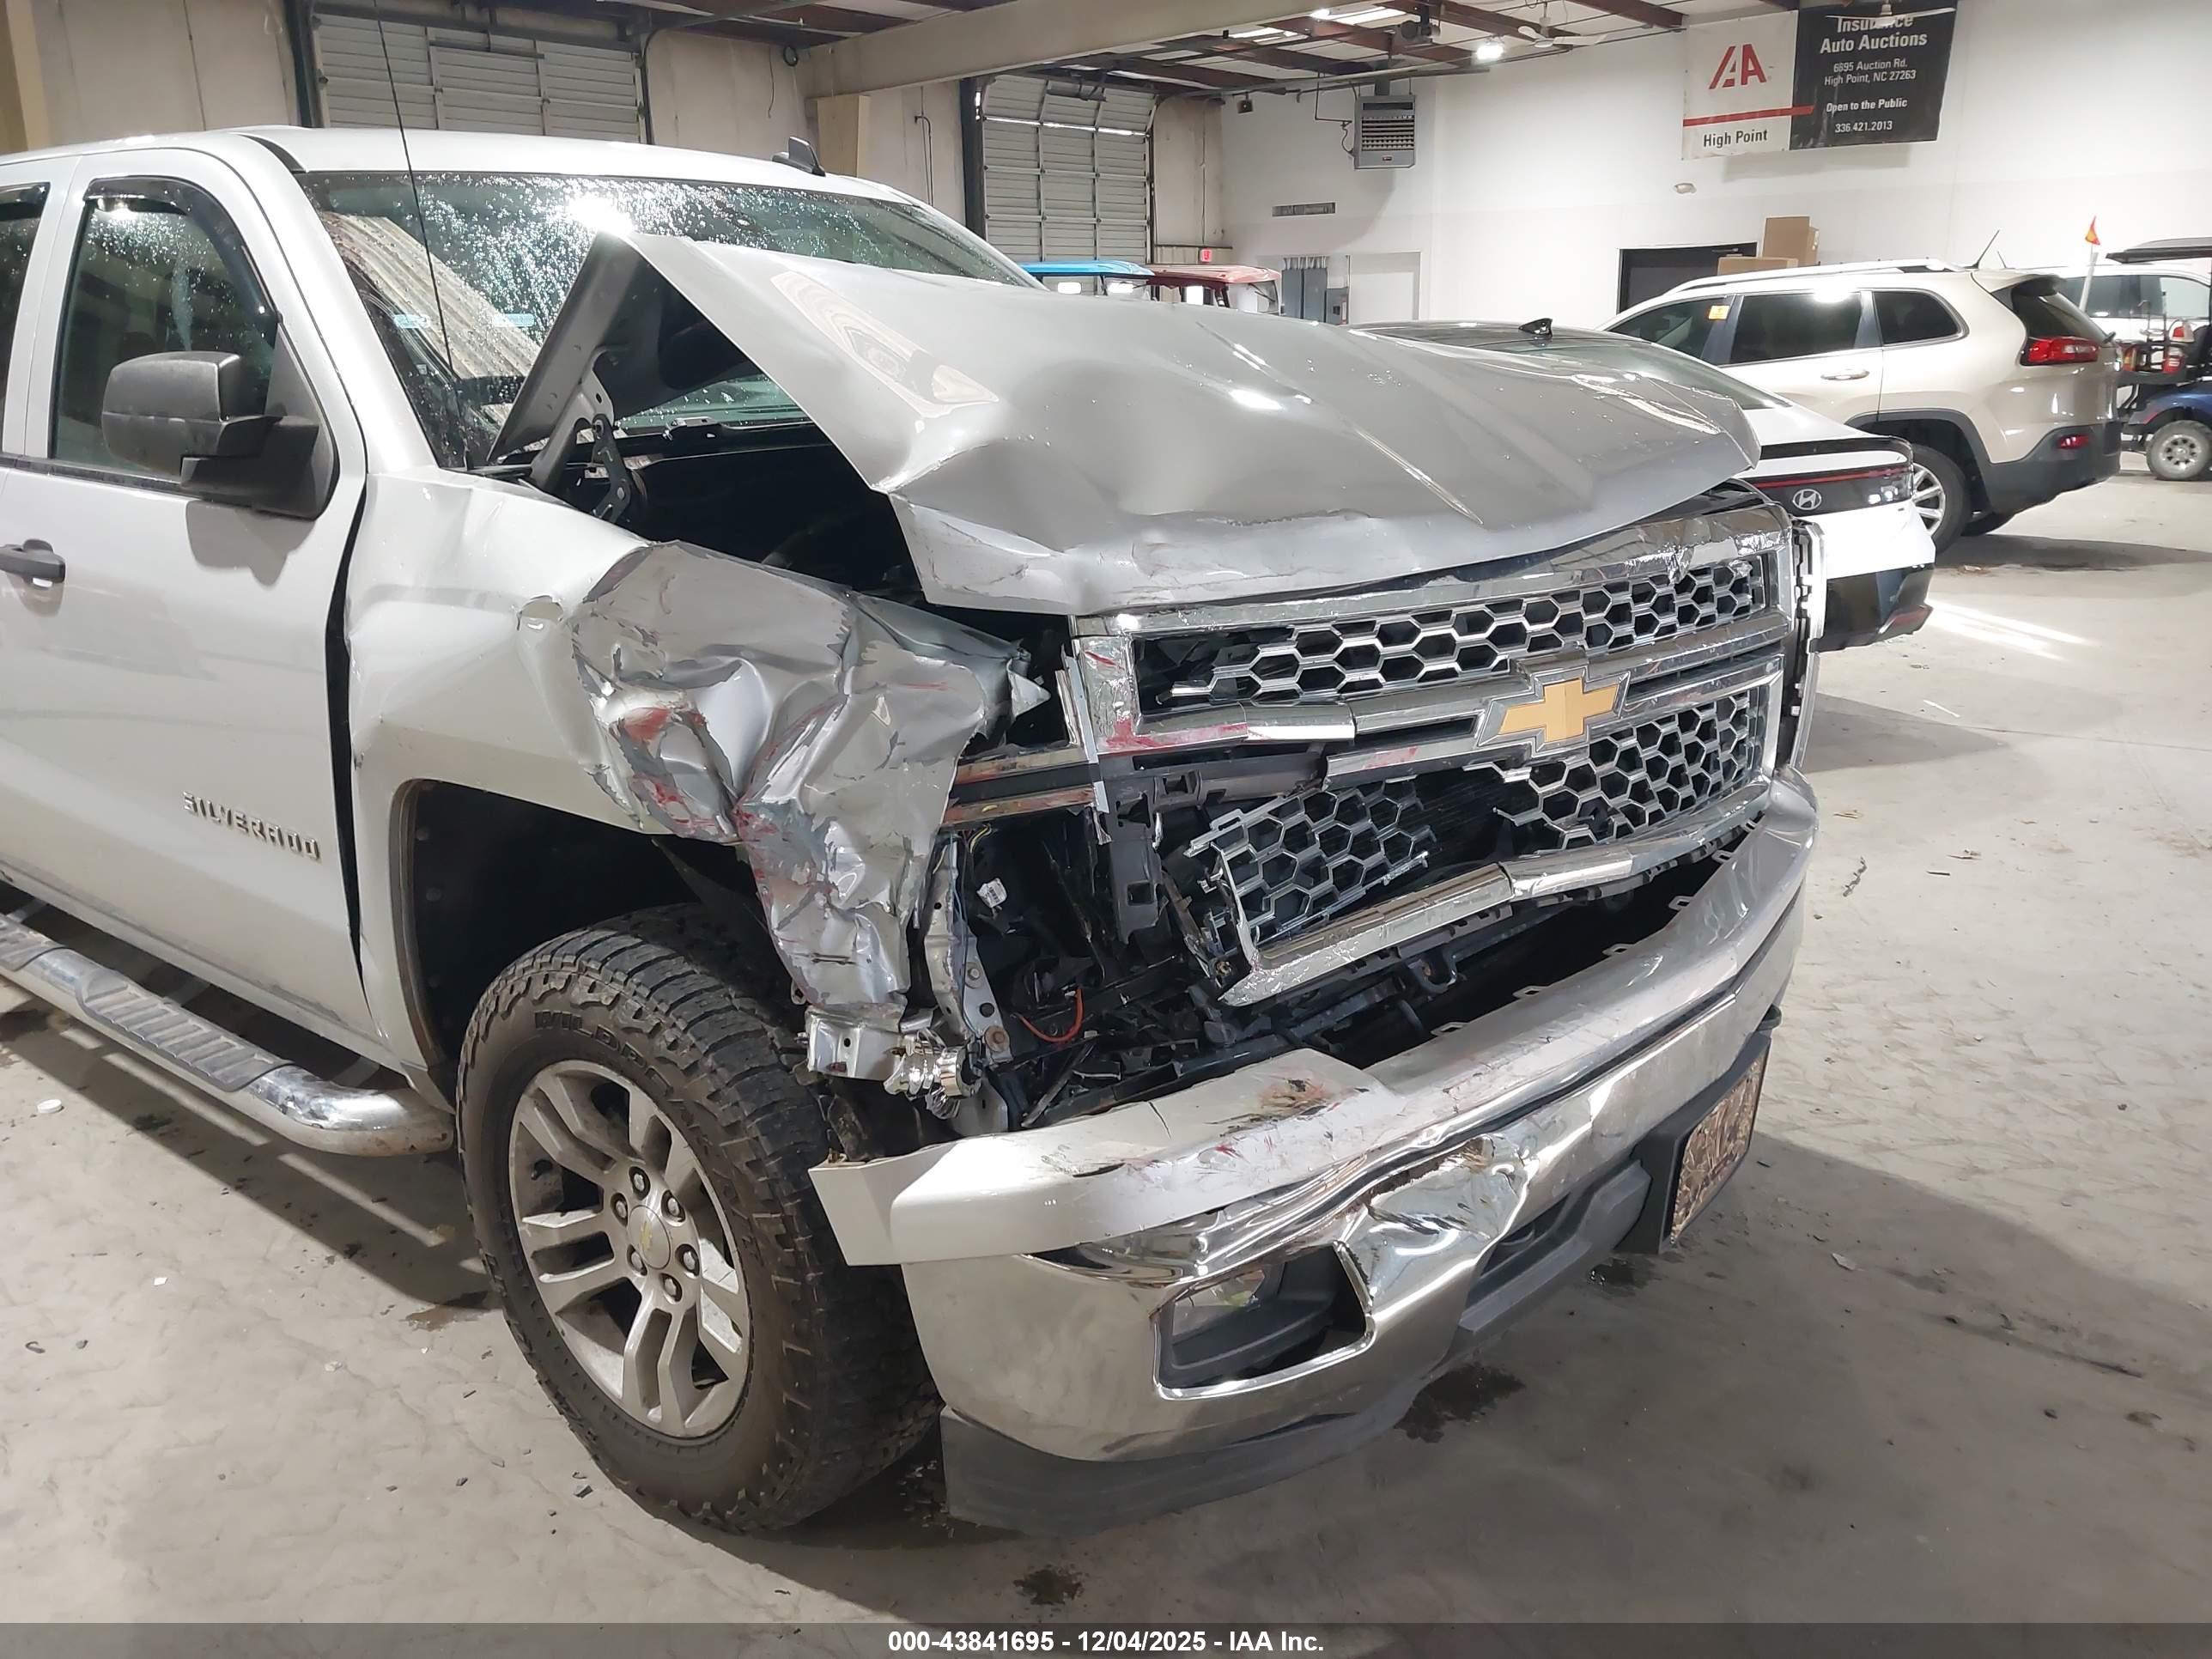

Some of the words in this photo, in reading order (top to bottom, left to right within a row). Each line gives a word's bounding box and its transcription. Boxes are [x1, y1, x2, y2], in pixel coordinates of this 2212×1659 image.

[1837, 15, 1914, 33] Insurce
[1820, 38, 1854, 54] Auto
[1858, 32, 1928, 51] Auctions
[1856, 60, 1891, 70] Auction
[1893, 58, 1908, 68] Rd.
[1825, 76, 1844, 87] High
[1846, 73, 1870, 83] Point,
[1873, 71, 1887, 82] NC
[1889, 70, 1917, 81] 27263
[1826, 102, 1848, 117] Open
[1861, 100, 1875, 110] the
[1878, 98, 1908, 108] Public
[1835, 120, 1893, 132] 336.421.2013
[1704, 132, 1731, 149] High
[1736, 129, 1768, 143] Point
[183, 791, 321, 860] SILVERADO
